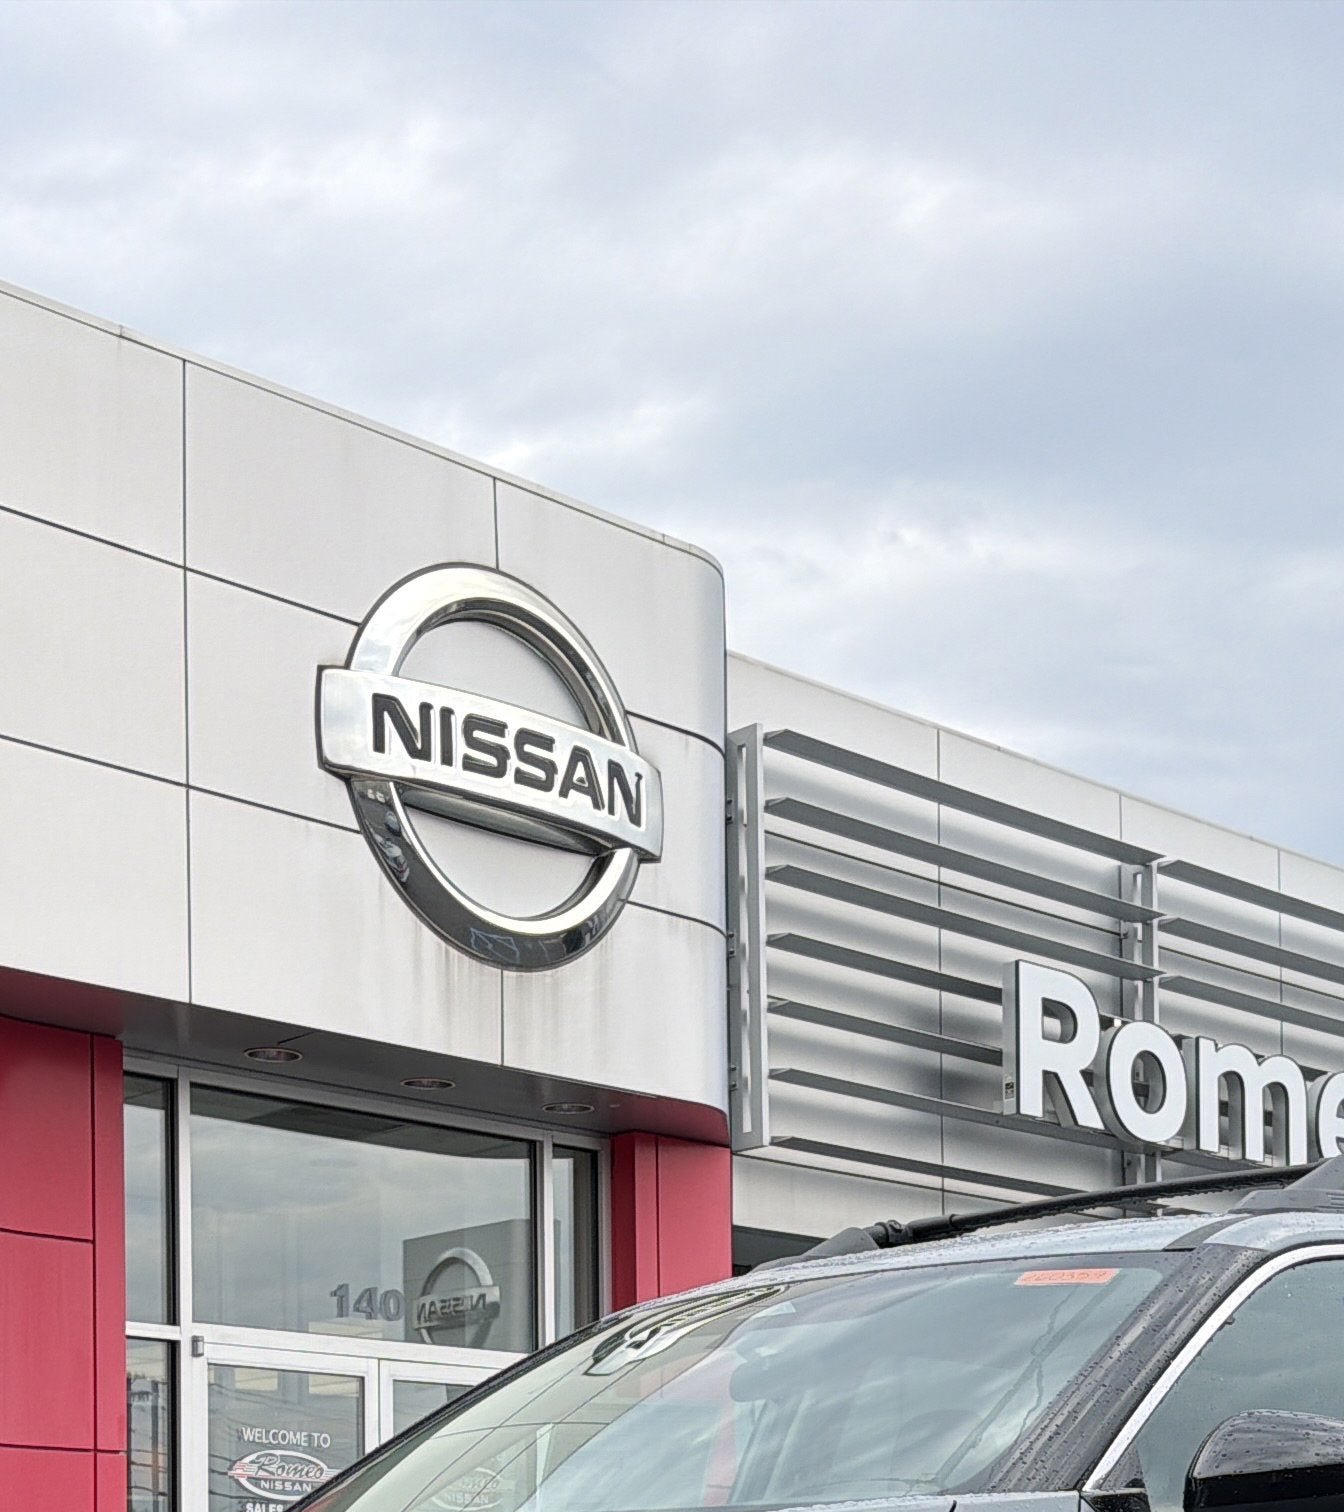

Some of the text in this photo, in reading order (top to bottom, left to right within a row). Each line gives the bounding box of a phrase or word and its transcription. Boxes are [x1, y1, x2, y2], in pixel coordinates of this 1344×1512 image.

[370, 691, 644, 828] NISSAN
[330, 1283, 405, 1322] 140
[241, 1427, 331, 1449] WELCOME TO
[249, 1452, 325, 1480] Romeo
[260, 1480, 312, 1492] NISSAN
